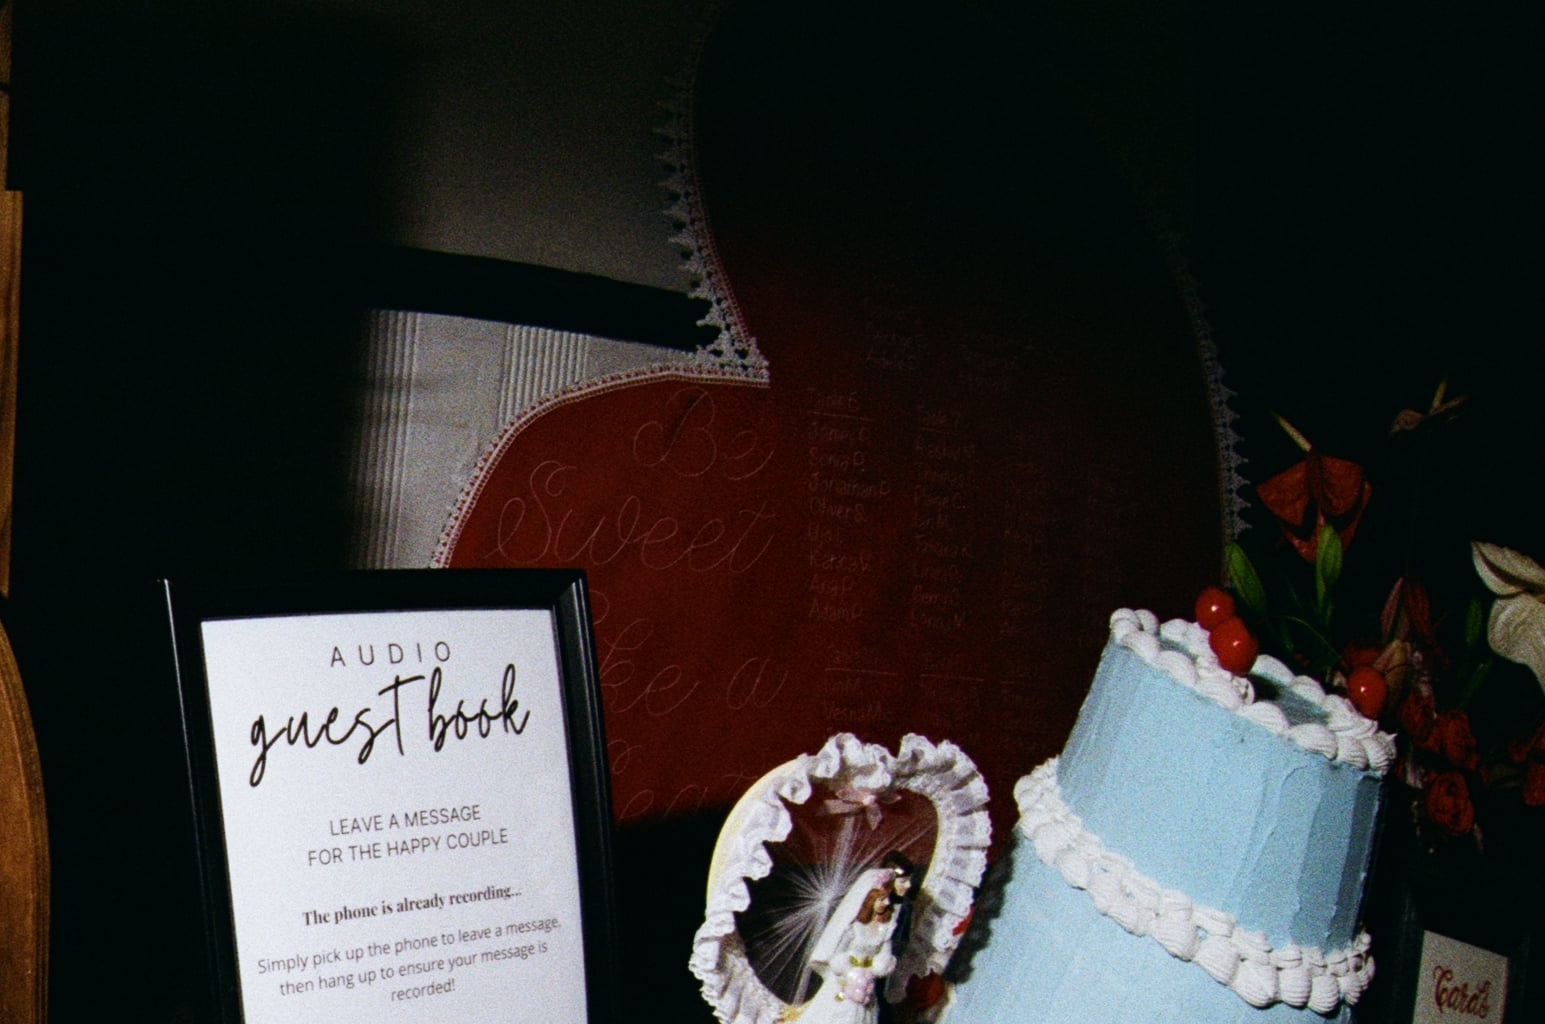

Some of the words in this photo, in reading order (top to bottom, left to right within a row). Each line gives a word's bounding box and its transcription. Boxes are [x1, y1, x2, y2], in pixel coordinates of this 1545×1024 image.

[483, 461, 776, 573] Sweet
[331, 641, 451, 667] AUDIO
[249, 675, 425, 787] guest
[428, 663, 530, 752] book
[330, 817, 384, 836] LEAVE
[389, 815, 400, 829] A
[405, 804, 481, 828] MESSAGE
[308, 848, 342, 866] FOR
[349, 844, 382, 860] THE
[387, 837, 440, 857] HAPPY
[446, 829, 508, 849] COUPLE
[303, 910, 331, 926] The
[334, 903, 378, 925] phone
[382, 899, 393, 914] is
[397, 893, 446, 912] already
[258, 955, 309, 975] Simply
[313, 947, 341, 968] pick
[346, 947, 365, 962] up
[368, 942, 390, 957] the
[395, 935, 438, 954] phone
[441, 933, 455, 946] to
[458, 926, 491, 943] leave
[495, 926, 502, 937] a
[280, 979, 314, 996] then
[318, 972, 354, 991] hang
[359, 968, 377, 984] up
[381, 966, 394, 979] to
[398, 959, 444, 977] ensure
[448, 954, 477, 970] your
[481, 945, 535, 963] message
[538, 940, 548, 954] is
[391, 977, 456, 1001] recorded!
